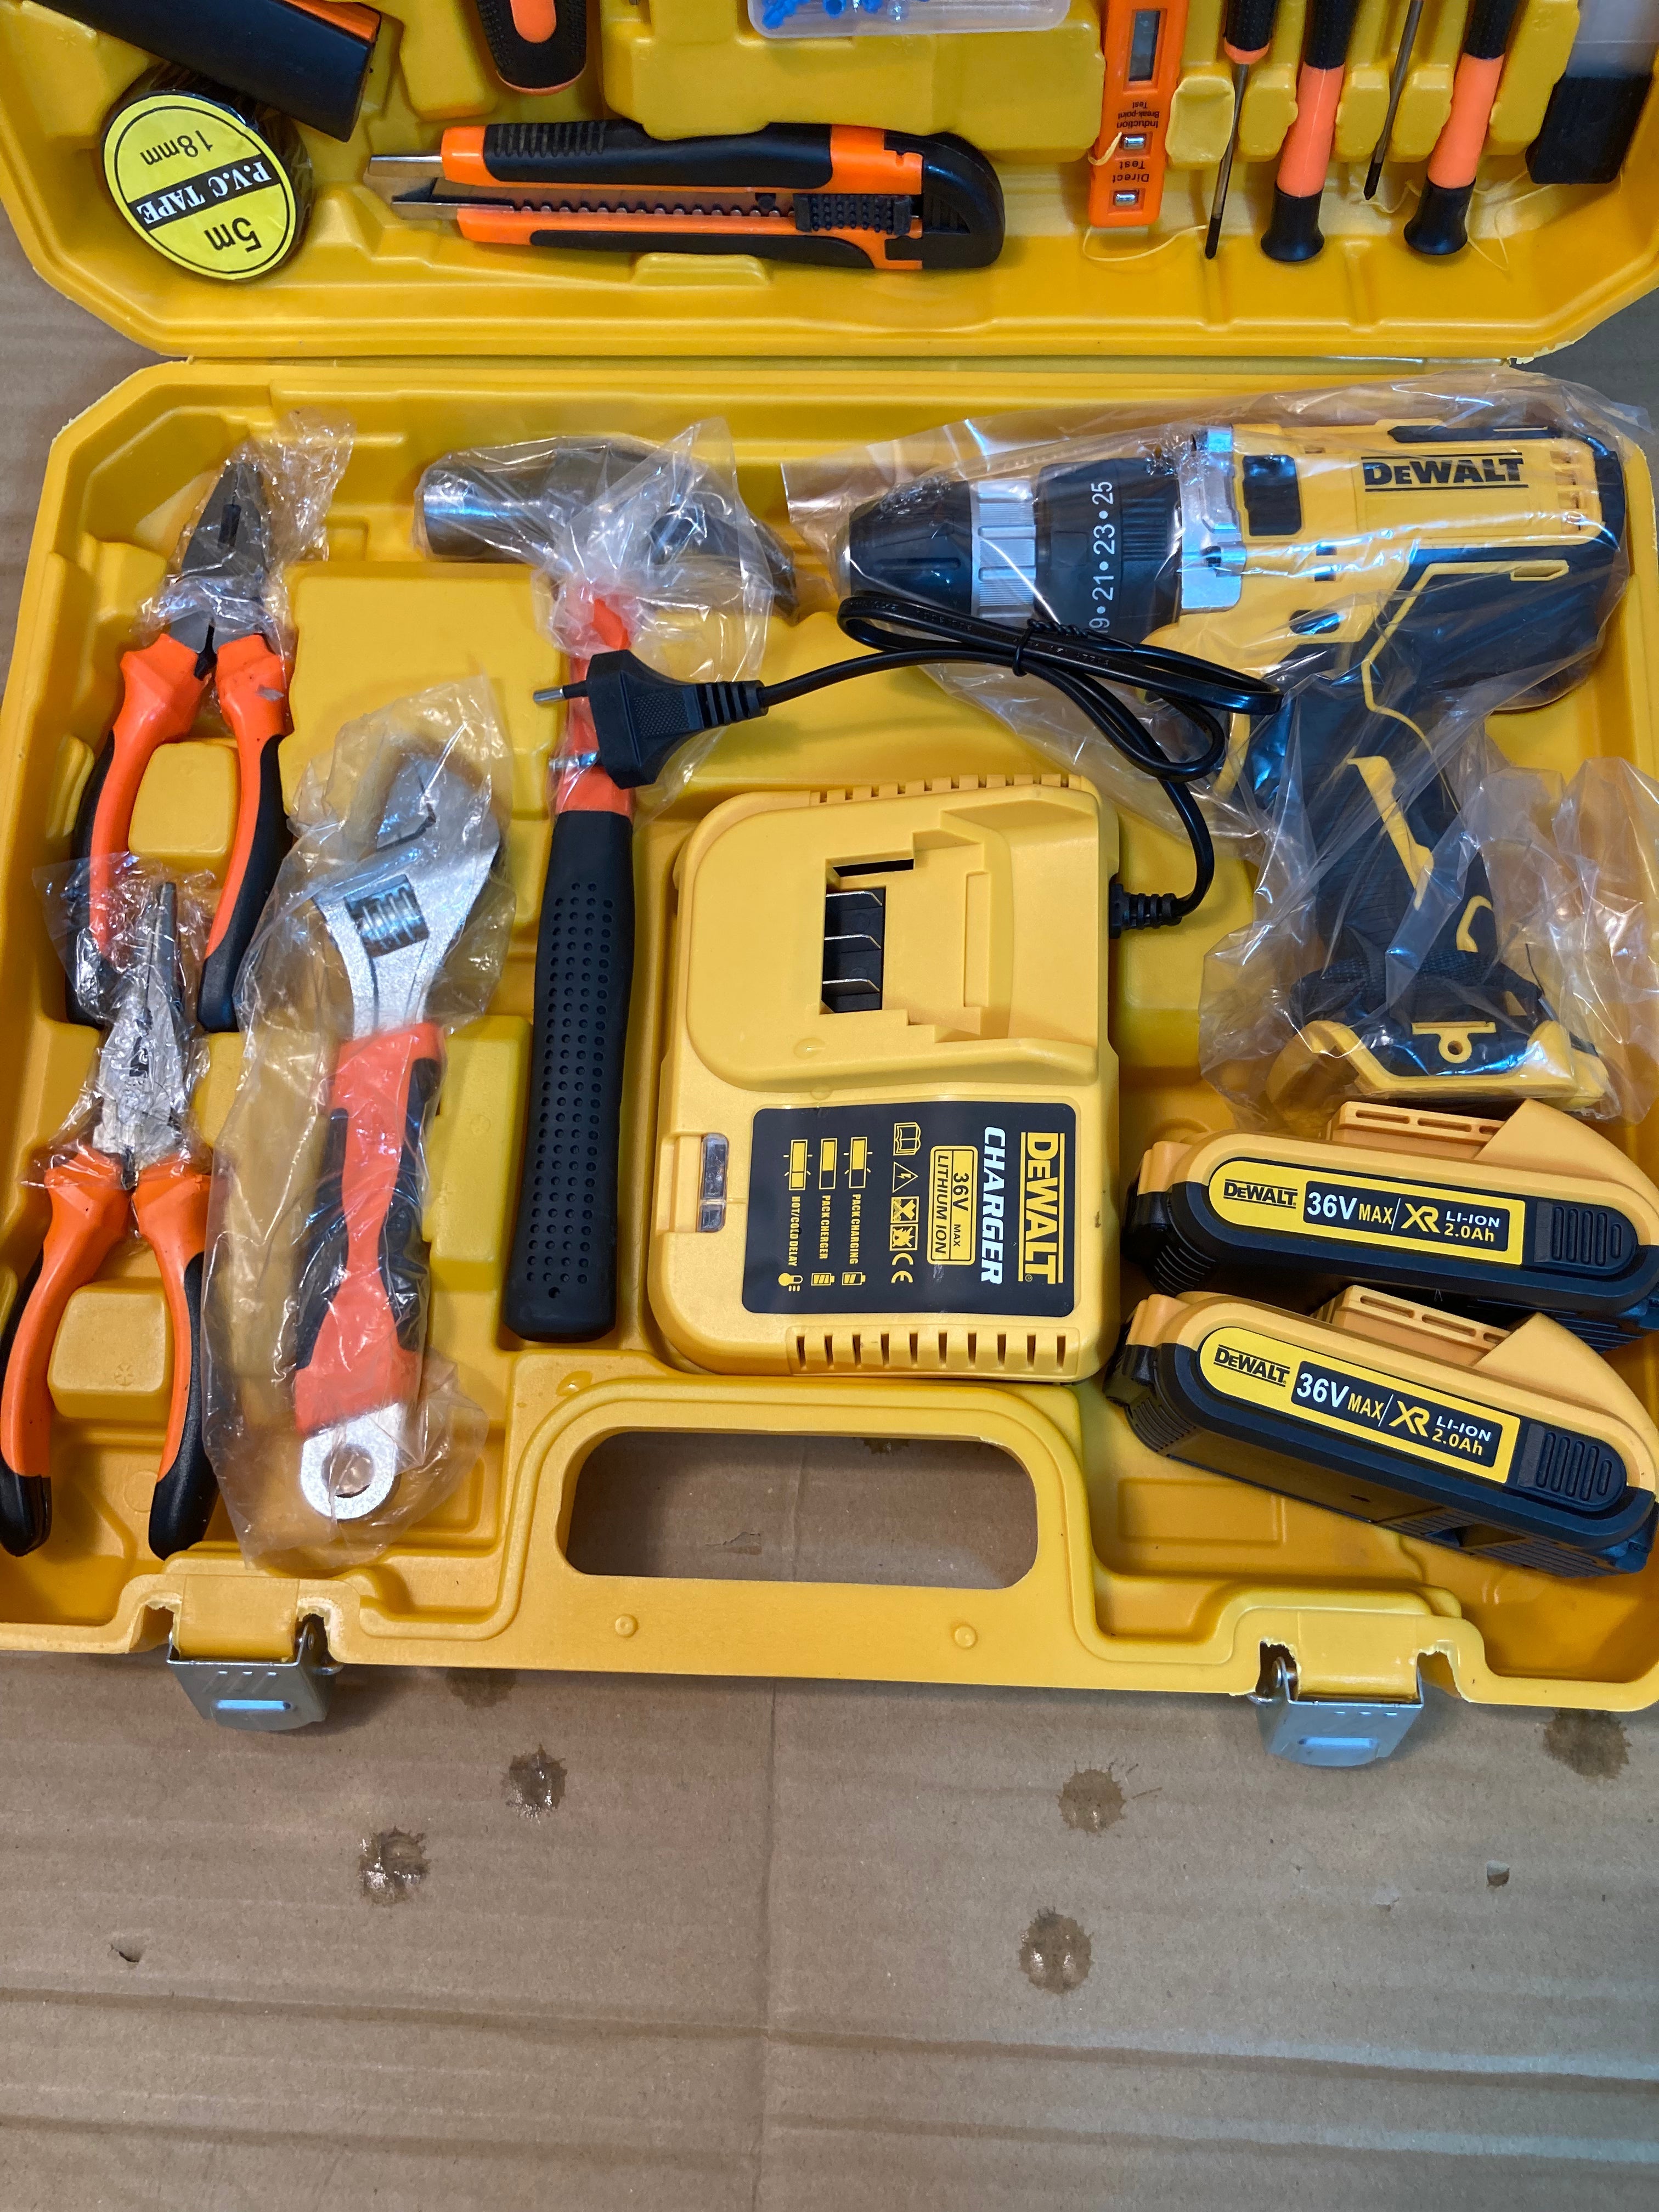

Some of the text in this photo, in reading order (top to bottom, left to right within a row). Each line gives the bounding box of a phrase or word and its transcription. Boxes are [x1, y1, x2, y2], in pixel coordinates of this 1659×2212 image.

[1116, 120, 1158, 129] Induction
[1118, 110, 1160, 120] Break-point
[140, 130, 213, 165] 18mm
[1112, 174, 1149, 183] Direct
[1120, 161, 1146, 170] Test
[136, 161, 272, 224] P.V.C TAPE
[204, 217, 262, 253] 5m
[1363, 458, 1524, 486] DEWALT
[1091, 481, 1114, 504] 25
[1093, 524, 1115, 555] 23
[1092, 575, 1114, 601] 21
[935, 1155, 949, 1254] LITHIUM ION
[981, 1126, 1006, 1284] CHARGER
[1025, 1132, 1059, 1284] DEWALT
[1223, 1181, 1297, 1206] DEWALT
[953, 1172, 969, 1247] 36V MAX
[1307, 1192, 1441, 1233] 36V MAX XR
[1445, 1210, 1500, 1228] LI-ION
[819, 1195, 831, 1259] PACK CHERGER
[849, 1194, 861, 1264] PACK CHARGING
[1444, 1223, 1495, 1242] 2.0Ah
[788, 1240, 798, 1266] DELAY
[1214, 1347, 1289, 1384] DEWALT
[1296, 1373, 1430, 1437] 36V MAX XR
[1432, 1428, 1483, 1455] 2.0Ah
[1437, 1415, 1492, 1442] LI-ION
